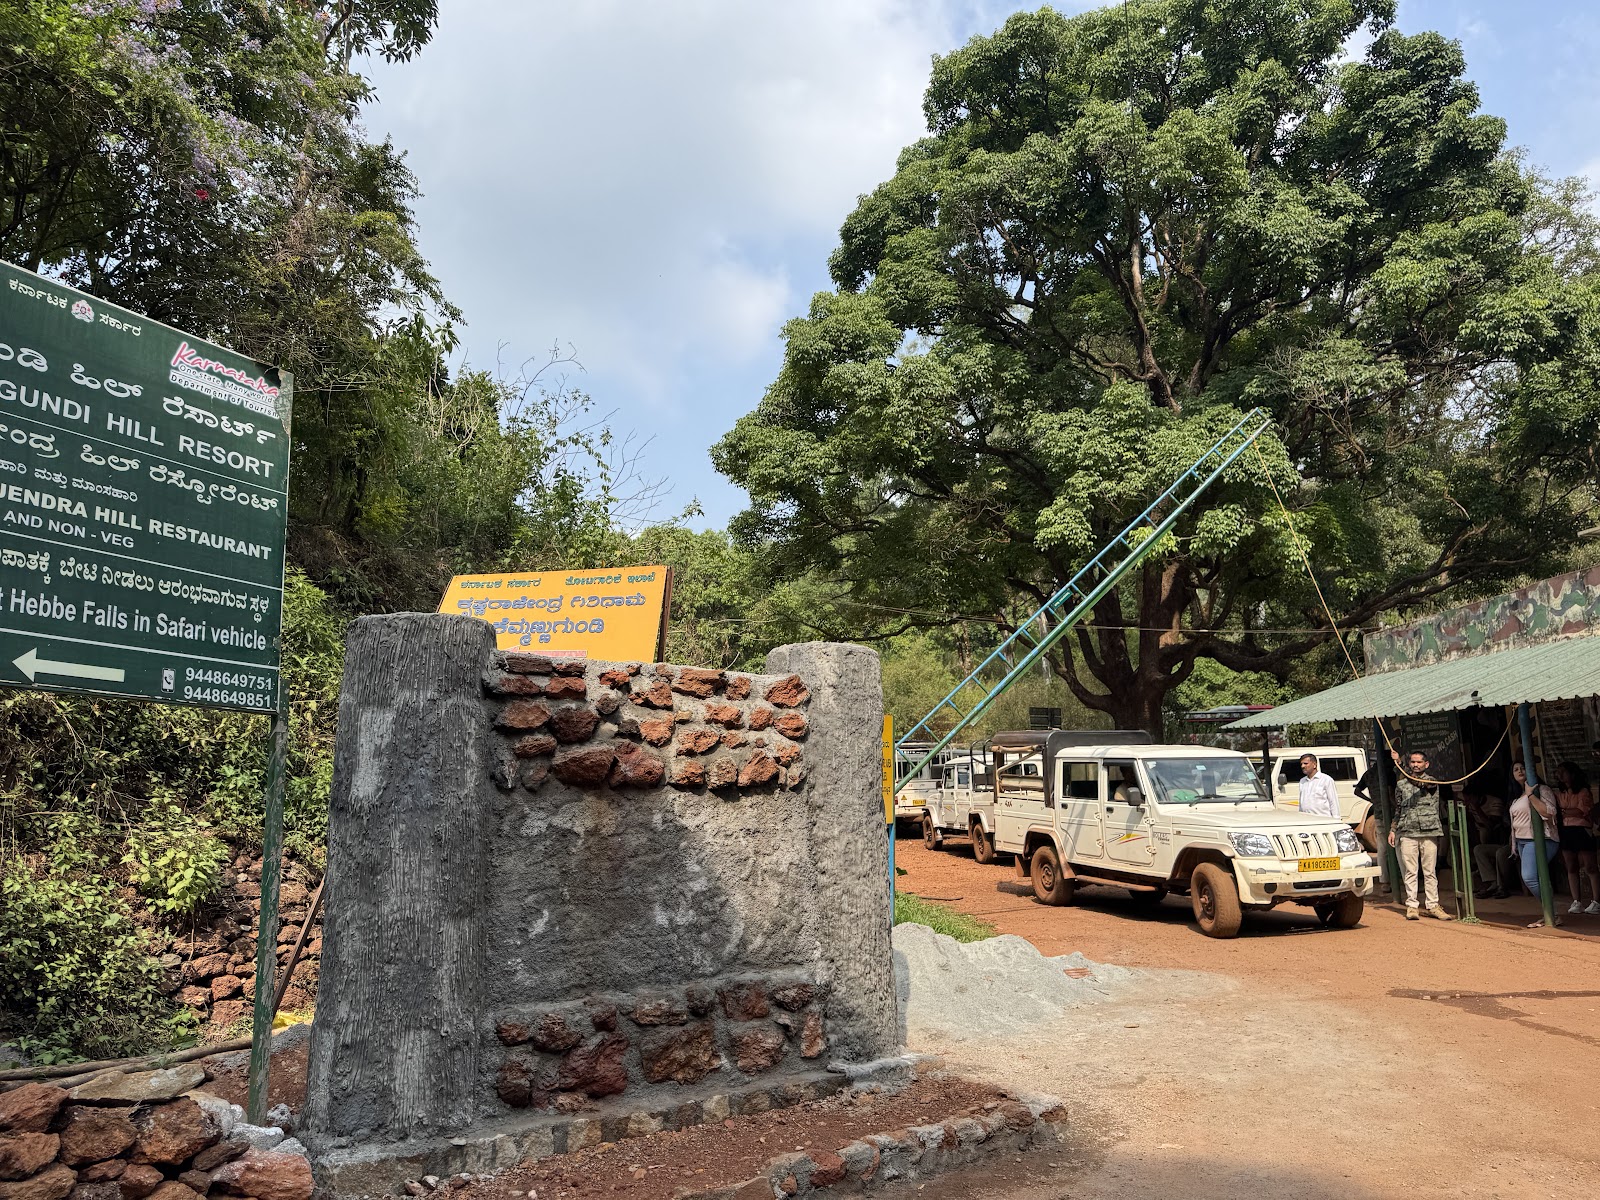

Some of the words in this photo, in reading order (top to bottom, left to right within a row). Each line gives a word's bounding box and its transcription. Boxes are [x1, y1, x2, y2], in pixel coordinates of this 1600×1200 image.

[9, 279, 68, 309] ಕರ್ನಾಟಕ
[99, 313, 142, 336] ಸರ್ಕಾರ
[170, 374, 229, 401] Department
[230, 396, 241, 405] of
[171, 341, 279, 398] Karnataka
[179, 364, 197, 376] One
[226, 381, 248, 396] Many
[250, 390, 278, 405] world
[70, 363, 143, 398] ಹಿಲ್
[162, 396, 276, 444] ರೆಸಾರ್ಟ್
[0, 379, 91, 424] GUNDI
[107, 412, 164, 447] HILL
[178, 434, 275, 478] RESORT
[80, 443, 142, 472] ಹಿಲ್
[34, 467, 68, 489] ಮತ್ತು
[71, 477, 138, 502] ಮಾಂಸಹಾರಿ
[3, 510, 43, 528] AND
[48, 519, 86, 539] NON
[101, 530, 135, 548] VEG
[94, 505, 143, 531] HILL
[149, 519, 272, 560] RESTAURANT
[0, 548, 52, 585] ಪಾತಕ್ಕೆ
[59, 556, 98, 582] ಬೇಟಿ
[101, 565, 155, 592] ನೀಡಲು
[158, 579, 248, 610] ಆರಂಭವಾಗುವ
[9, 587, 77, 621] Hebbe
[82, 600, 128, 630] Falls
[133, 608, 151, 633] in
[156, 612, 206, 642] Safari
[210, 625, 266, 651] vehicle
[183, 685, 271, 708] 9448649851
[185, 667, 273, 691] 9448649751
